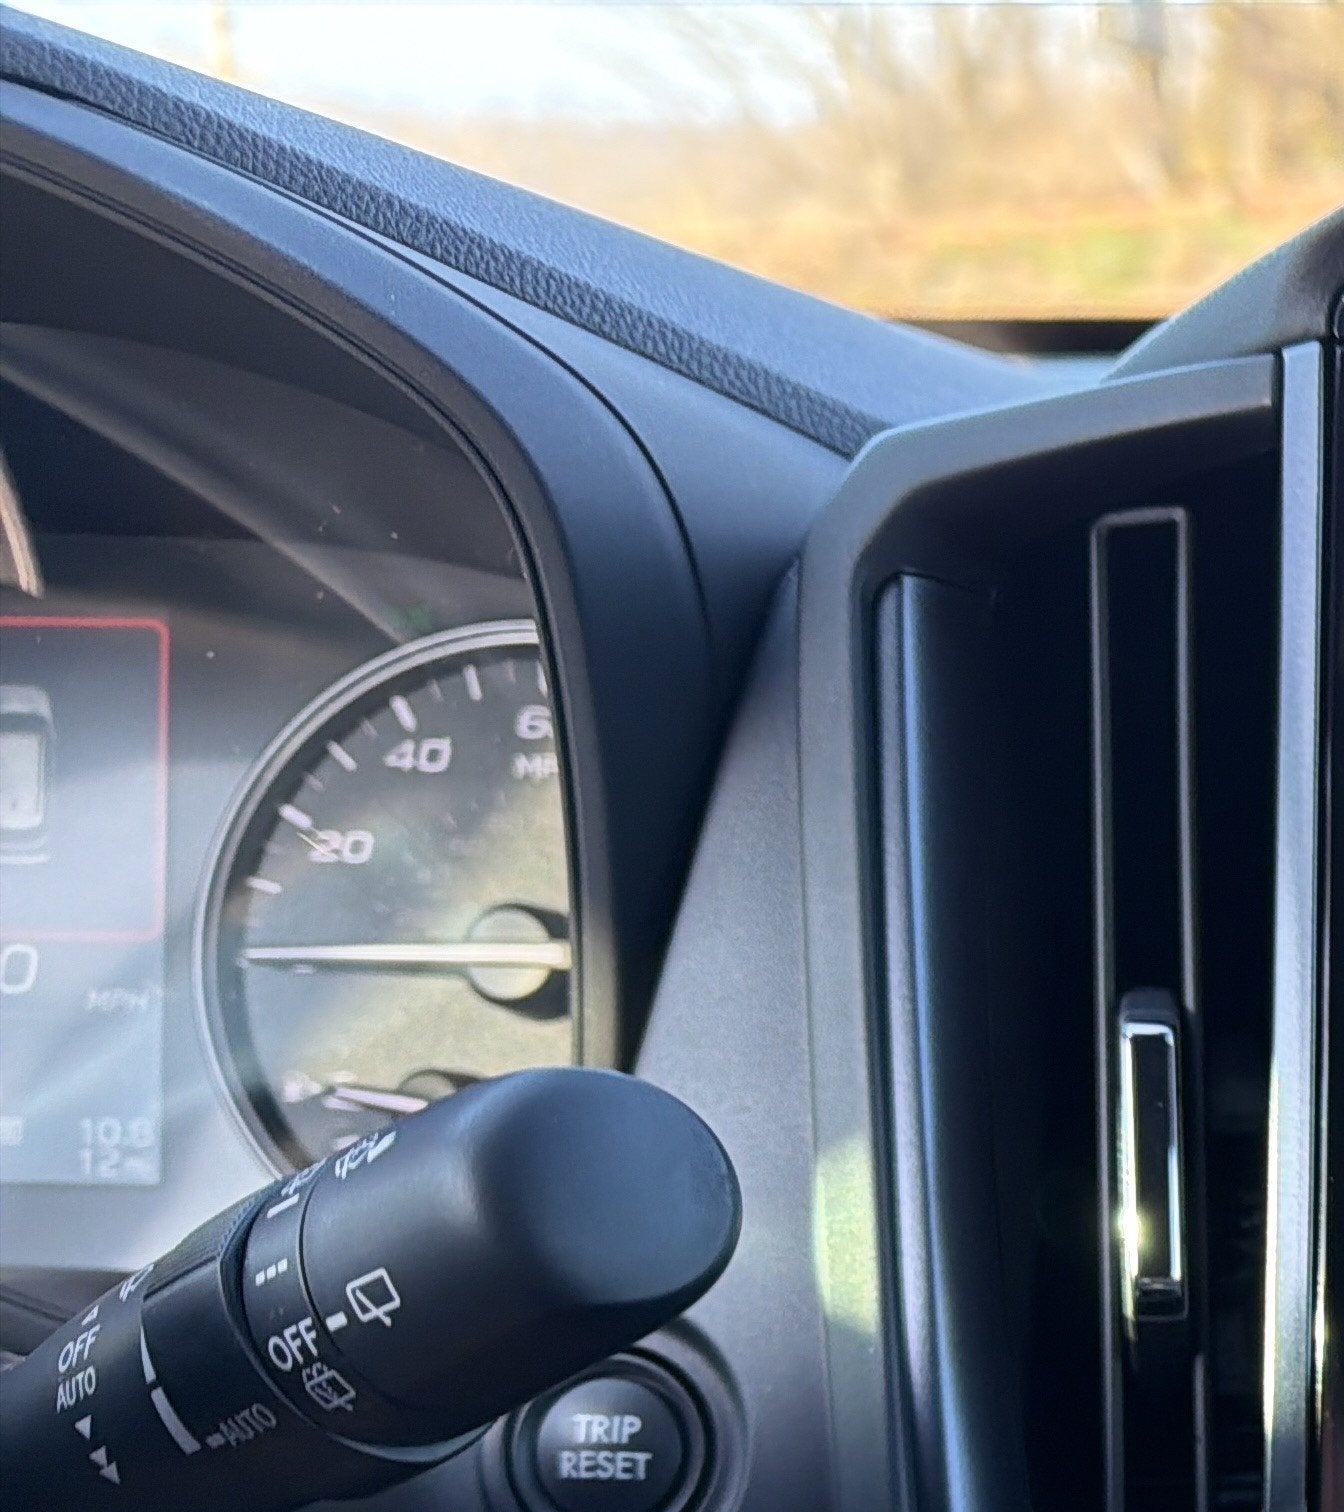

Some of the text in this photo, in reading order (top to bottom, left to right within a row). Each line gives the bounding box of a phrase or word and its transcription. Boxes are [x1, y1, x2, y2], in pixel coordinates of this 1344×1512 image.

[515, 704, 554, 740] 6
[383, 736, 452, 774] 40
[512, 751, 559, 780] MP
[309, 829, 375, 865] 20
[57, 1323, 100, 1375] OFF
[267, 1316, 323, 1373] OFF
[56, 1366, 98, 1415] AUTO
[219, 1402, 278, 1448] AUTO
[572, 1412, 642, 1444] TRIP
[560, 1449, 653, 1480] RESET
